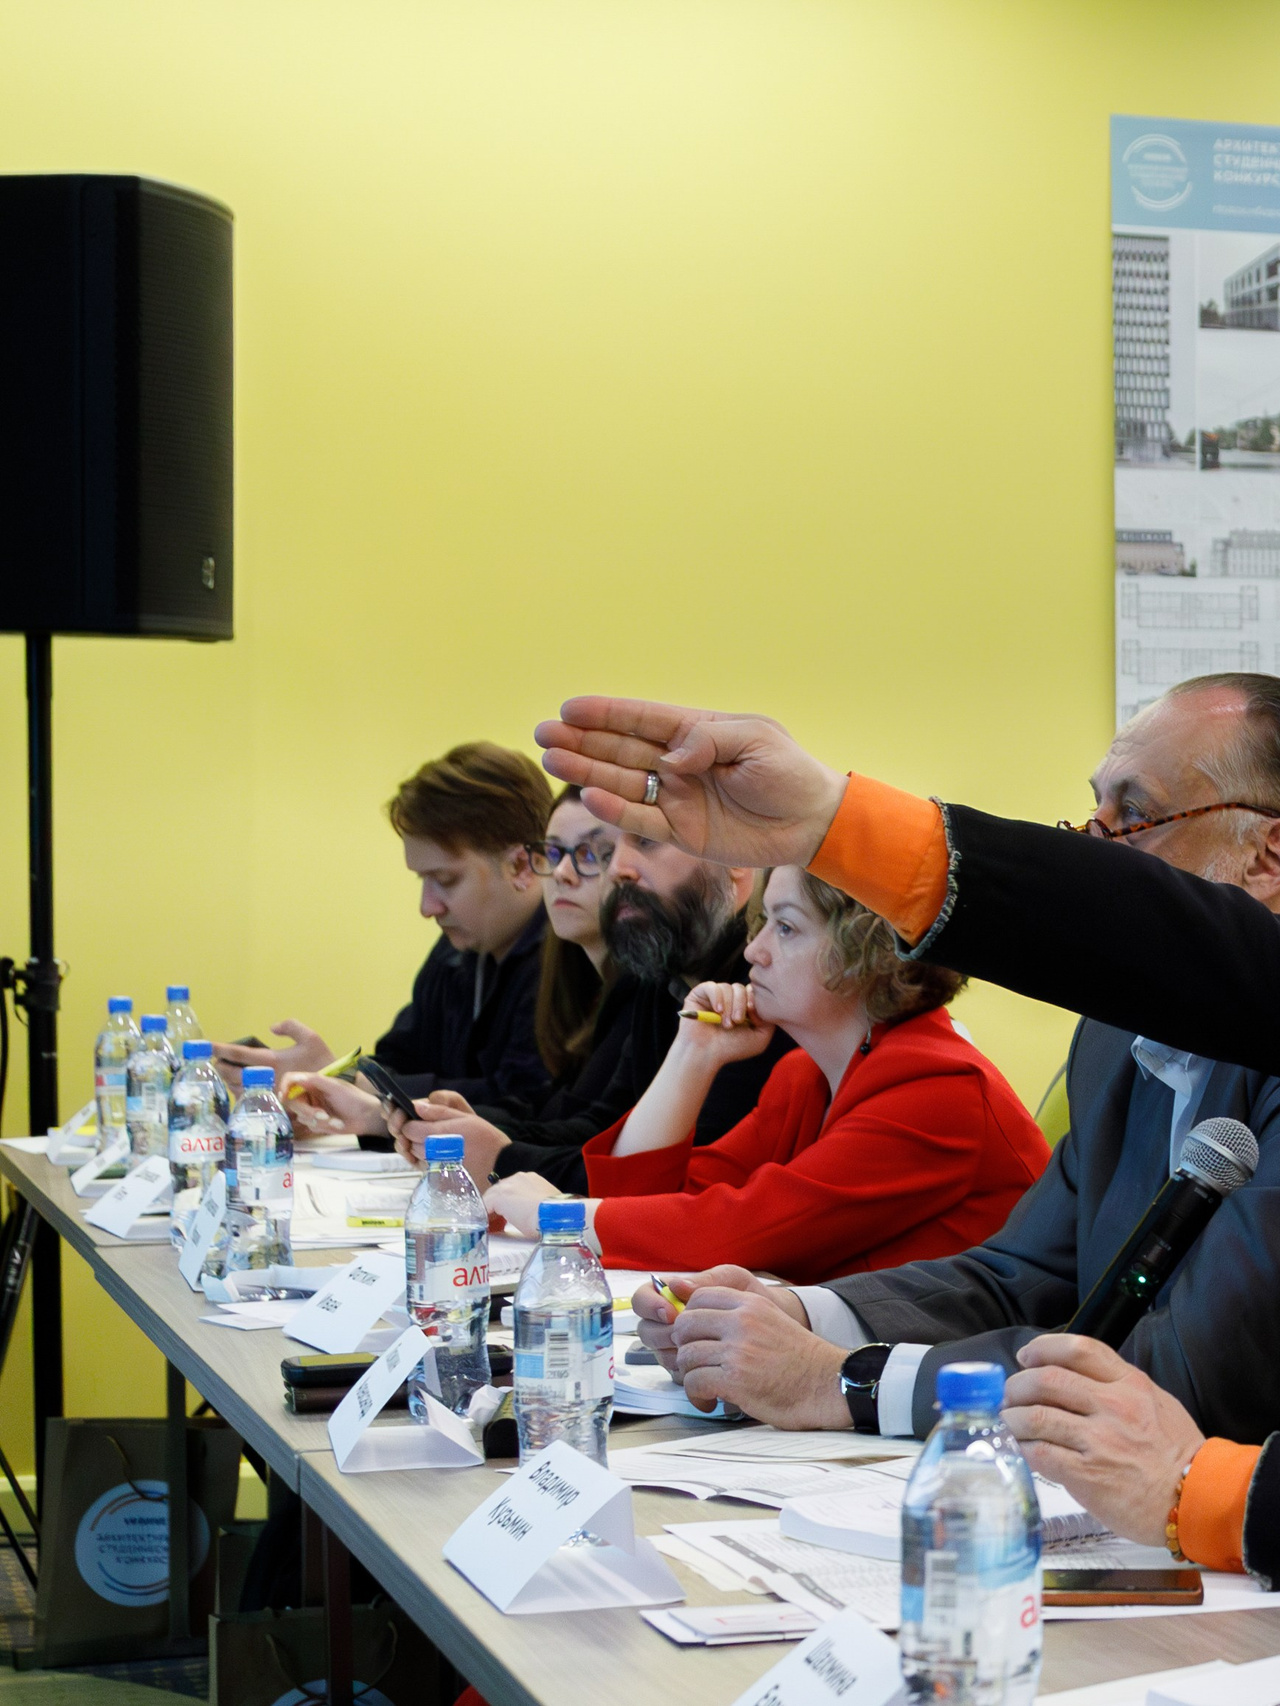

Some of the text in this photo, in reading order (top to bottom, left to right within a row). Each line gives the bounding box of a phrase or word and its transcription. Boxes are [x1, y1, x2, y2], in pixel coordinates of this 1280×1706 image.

[1213, 170, 1280, 187] КОНКУРС
[529, 1460, 580, 1511] Владимир
[487, 1496, 533, 1541] Кузьмин
